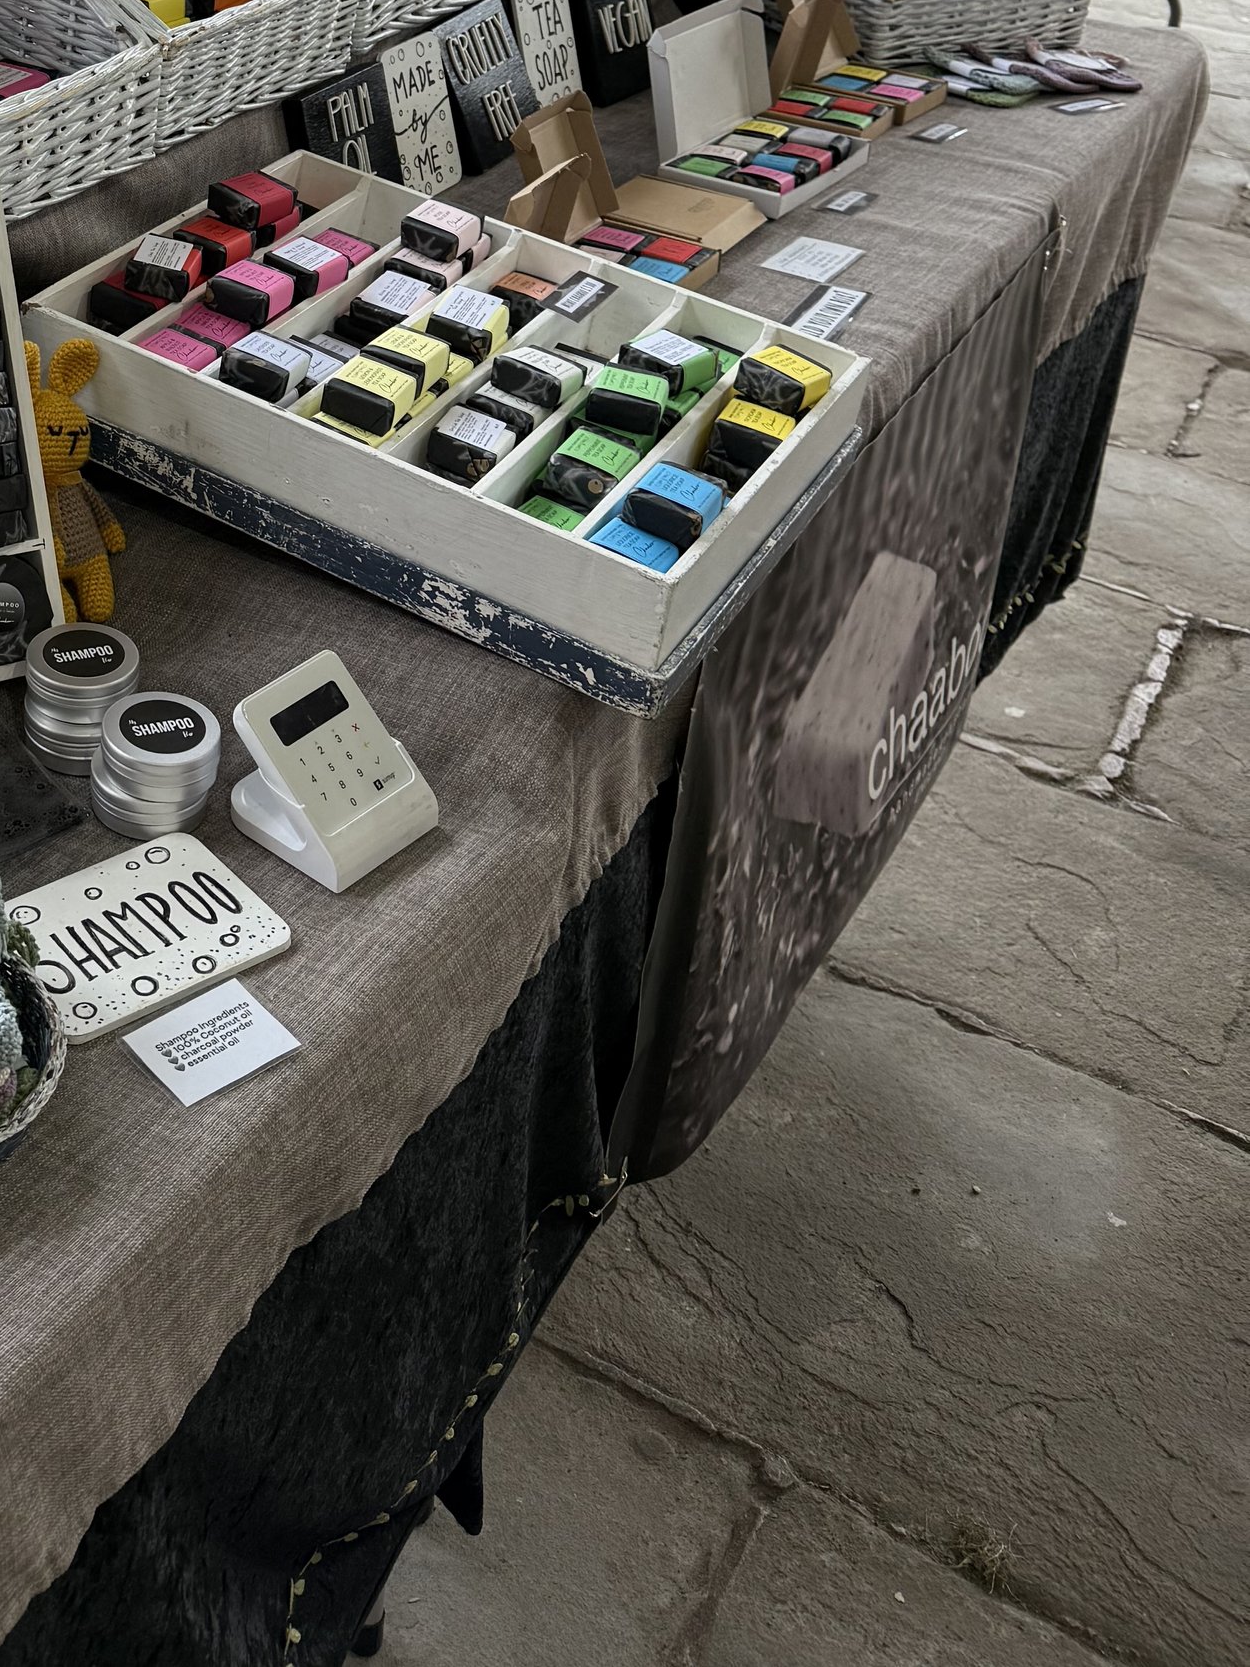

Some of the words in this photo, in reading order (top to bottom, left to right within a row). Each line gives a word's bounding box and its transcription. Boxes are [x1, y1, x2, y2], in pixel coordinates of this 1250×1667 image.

[447, 12, 514, 85] CRUELTY
[535, 44, 569, 91] SOAP
[392, 61, 436, 103] MADE
[326, 82, 375, 143] PALM
[413, 145, 441, 182] ME
[54, 645, 114, 664] SHAMPOO
[131, 717, 195, 738] SHAMPOO
[334, 734, 343, 743] 3
[317, 745, 326, 755] 2
[345, 751, 353, 761] 6
[299, 757, 307, 767] 1
[327, 762, 336, 772] 5
[311, 774, 318, 784] 4
[356, 768, 364, 778] 9
[338, 780, 347, 790] 8
[320, 792, 328, 802] 7
[349, 797, 358, 807] 0
[35, 871, 243, 994] SHAMPOO
[155, 1027, 199, 1052] Shampoo
[198, 1001, 250, 1030] Ingredients
[173, 1036, 201, 1053] 100%
[200, 1015, 241, 1040] Coconut
[240, 1009, 253, 1019] oil
[180, 1037, 220, 1060] charcoal
[219, 1019, 254, 1042] powder
[187, 1044, 229, 1067] essential
[227, 1036, 240, 1047] oil
